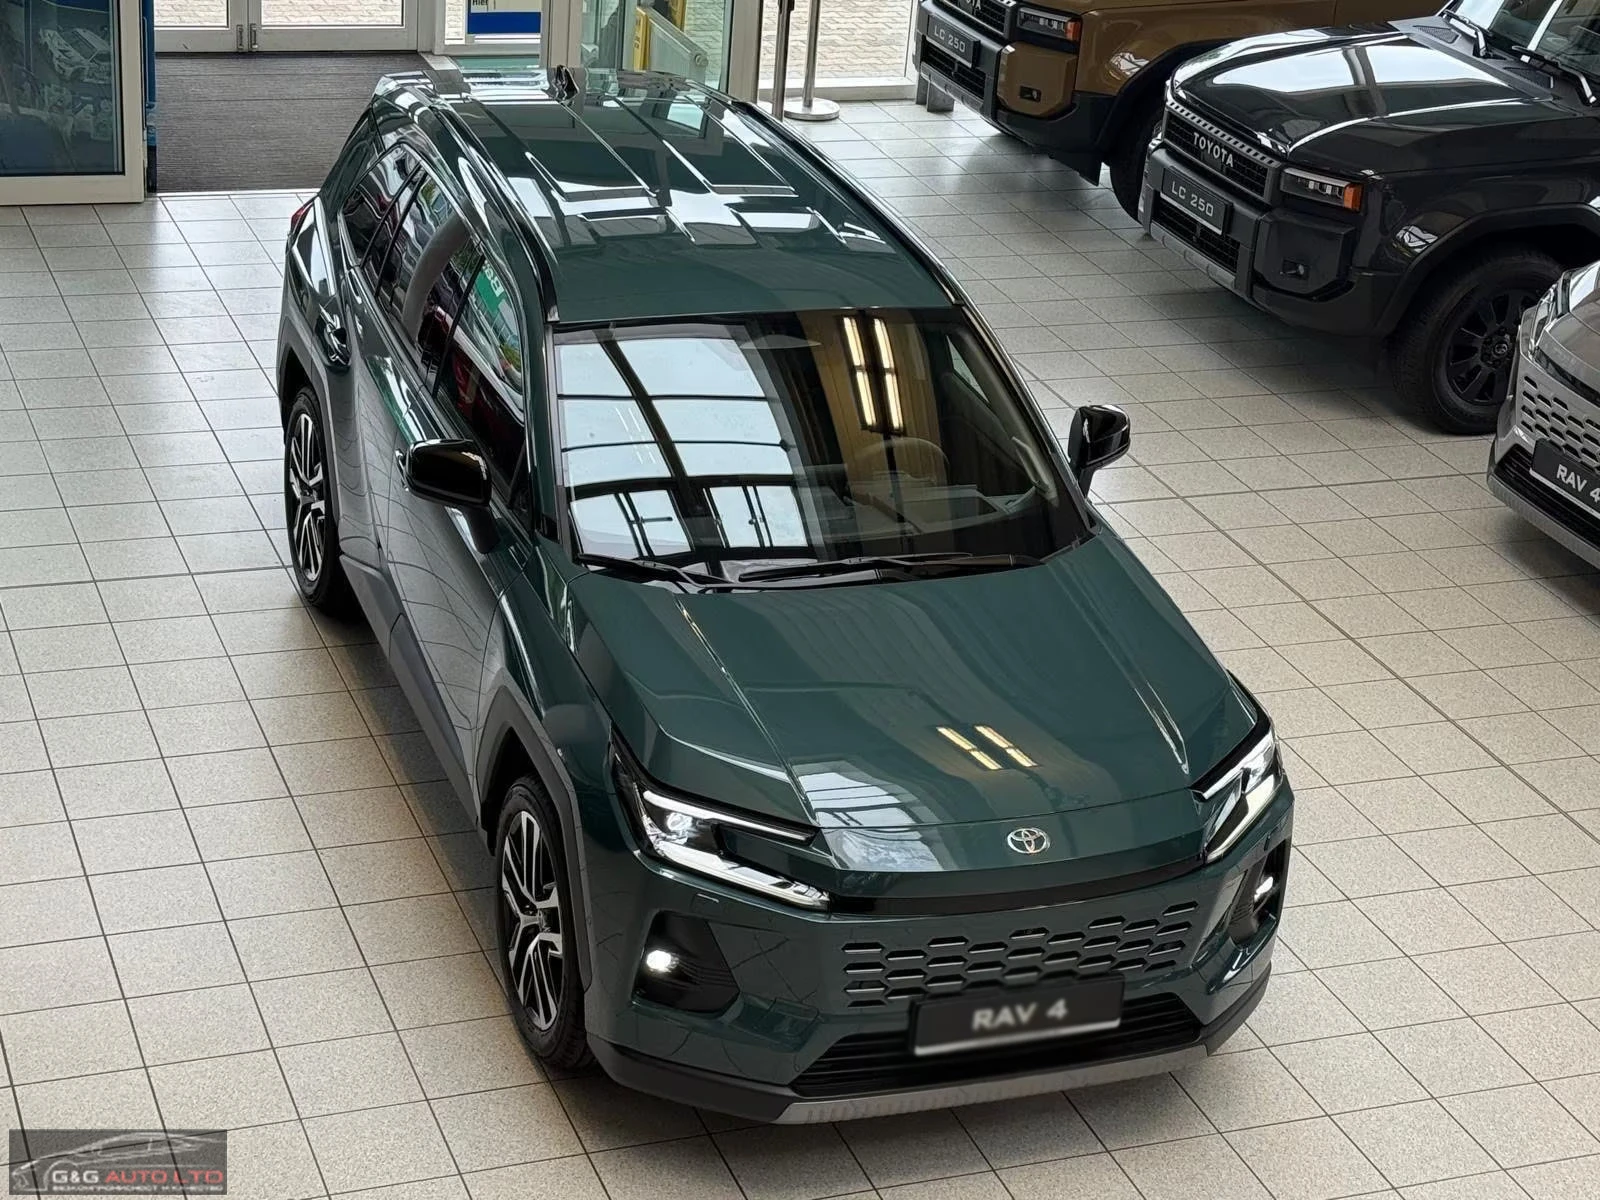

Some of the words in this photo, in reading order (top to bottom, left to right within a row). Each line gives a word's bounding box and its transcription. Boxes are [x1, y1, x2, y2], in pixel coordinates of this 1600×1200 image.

[934, 25, 946, 40] LC
[948, 34, 966, 53] 250
[1193, 132, 1234, 168] TOYOTA
[1171, 181, 1186, 200] LC
[1190, 194, 1214, 217] 250
[1556, 464, 1588, 492] RAV
[1589, 487, 1600, 503] 4
[972, 1002, 1038, 1031] RAV
[1046, 998, 1069, 1020] 4
